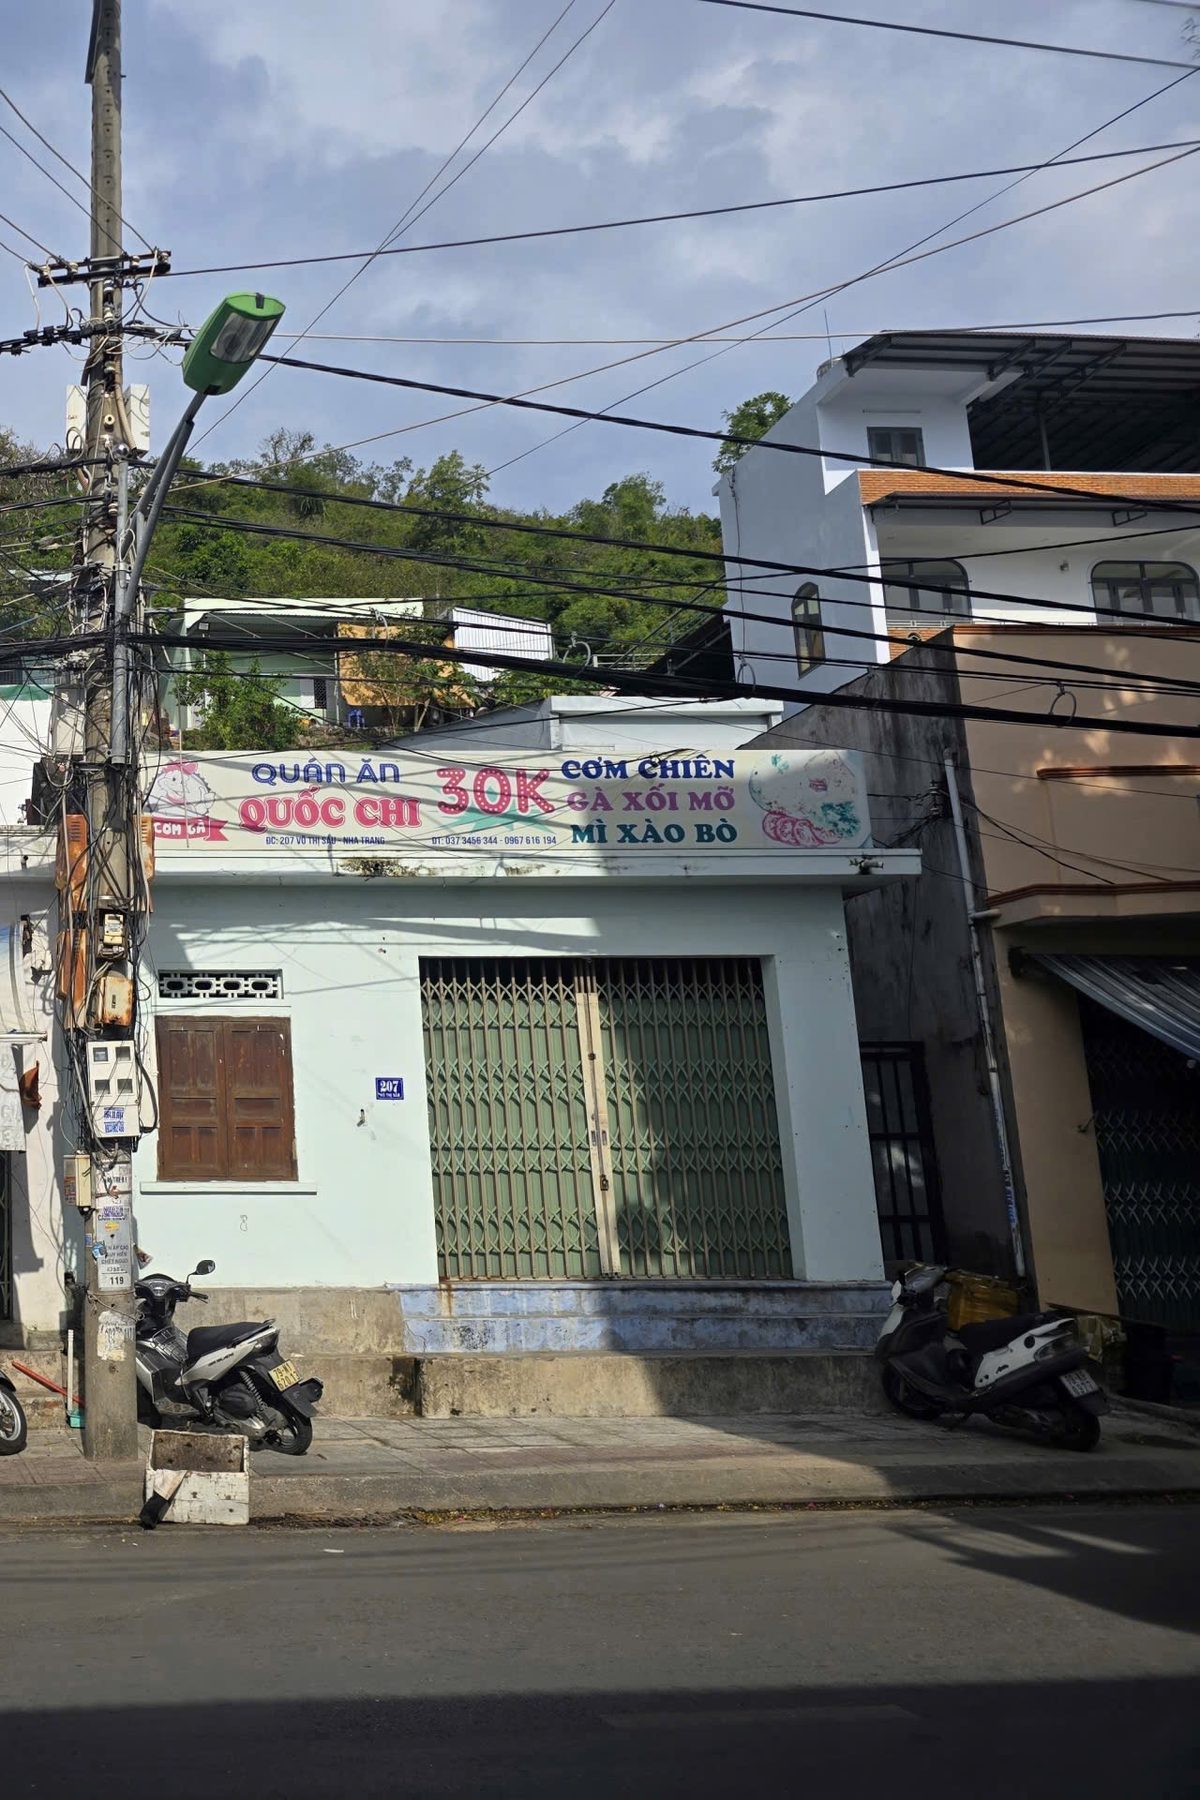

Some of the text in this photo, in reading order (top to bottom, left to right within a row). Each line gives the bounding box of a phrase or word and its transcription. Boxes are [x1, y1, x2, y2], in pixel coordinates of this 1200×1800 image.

[251, 757, 400, 786] QUÁN ĂN
[561, 754, 736, 779] CƠM CHIÊN
[436, 766, 555, 815] 30K
[566, 783, 735, 811] GÀ XỐI MỠ
[239, 785, 421, 834] QUỐC CHI
[153, 822, 182, 836] CƠM
[280, 836, 294, 845] 207
[343, 836, 359, 845] NHA
[360, 836, 385, 845] TRANG
[446, 836, 460, 845] 037
[462, 836, 481, 845] 3456
[483, 836, 498, 845] 344
[504, 836, 523, 845] 0967
[525, 836, 541, 845] 616
[543, 836, 557, 845] 194
[570, 818, 738, 844] MÌ XÀO BÒ
[380, 1080, 399, 1092] 207
[110, 1276, 124, 1285] 119
